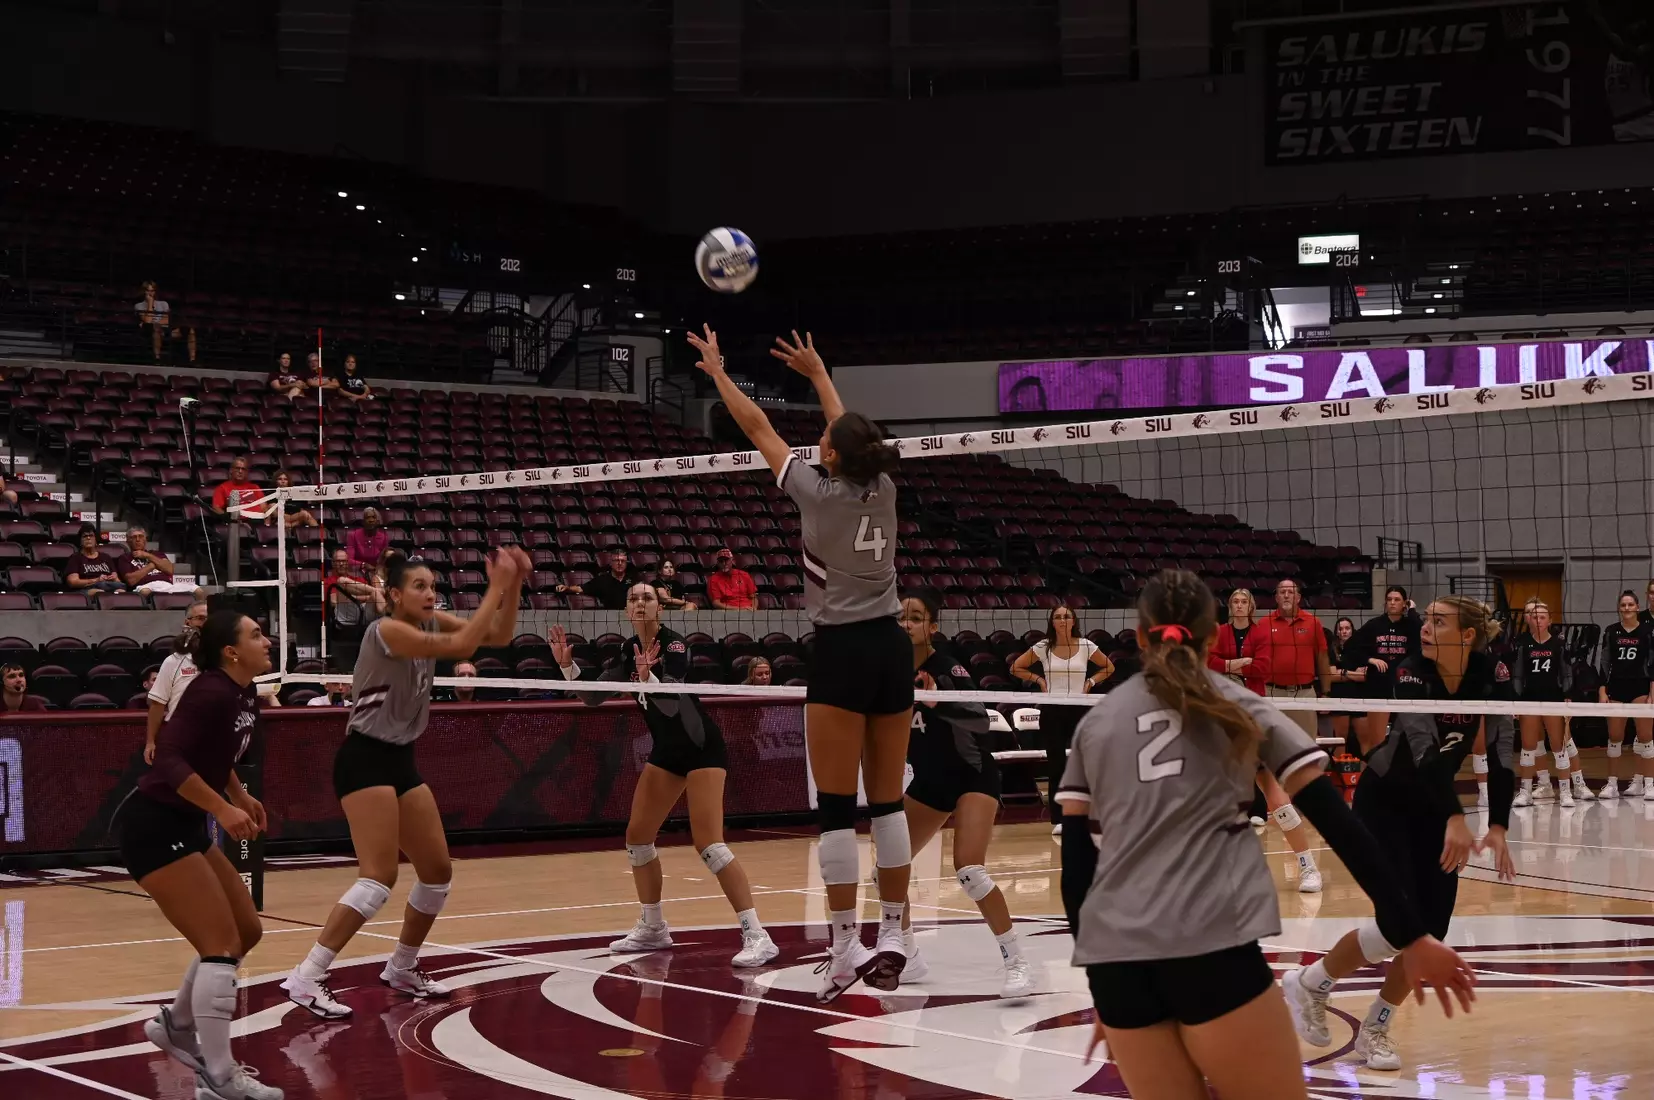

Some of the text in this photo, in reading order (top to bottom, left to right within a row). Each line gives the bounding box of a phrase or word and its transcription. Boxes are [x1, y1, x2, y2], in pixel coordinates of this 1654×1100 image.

[1276, 22, 1490, 67] SALUKIS
[1277, 65, 1372, 87] IN THE
[1525, 6, 1571, 146] 1977
[1276, 81, 1443, 122] SWEET
[1276, 115, 1483, 159] SIXTEEN
[500, 258, 521, 272] 202
[1218, 260, 1241, 273] 203
[1335, 254, 1359, 267] 204
[616, 268, 636, 281] 203
[612, 348, 629, 361] 102
[354, 483, 367, 494] SIU
[393, 481, 407, 491] SIU
[435, 477, 450, 488] SIU
[479, 474, 494, 485] SIU
[525, 470, 541, 481] SIU
[573, 467, 590, 478] SIU
[623, 462, 641, 474] SIU
[677, 457, 695, 470] SIU
[732, 453, 752, 465] SIU
[792, 448, 812, 461] SIU
[921, 437, 944, 451] SIU
[991, 431, 1015, 445] SIU
[1066, 425, 1091, 440] SIU
[1145, 417, 1172, 432] SIU
[1229, 410, 1258, 426] SIU
[1320, 402, 1351, 419] SIU
[1417, 392, 1450, 410] SIU
[1520, 382, 1556, 401] SIU
[1631, 374, 1654, 391] SI
[853, 515, 888, 562] 4
[1617, 647, 1638, 660] 16
[1531, 658, 1552, 673] 14
[1136, 708, 1185, 783] 2
[1440, 731, 1465, 753] 2
